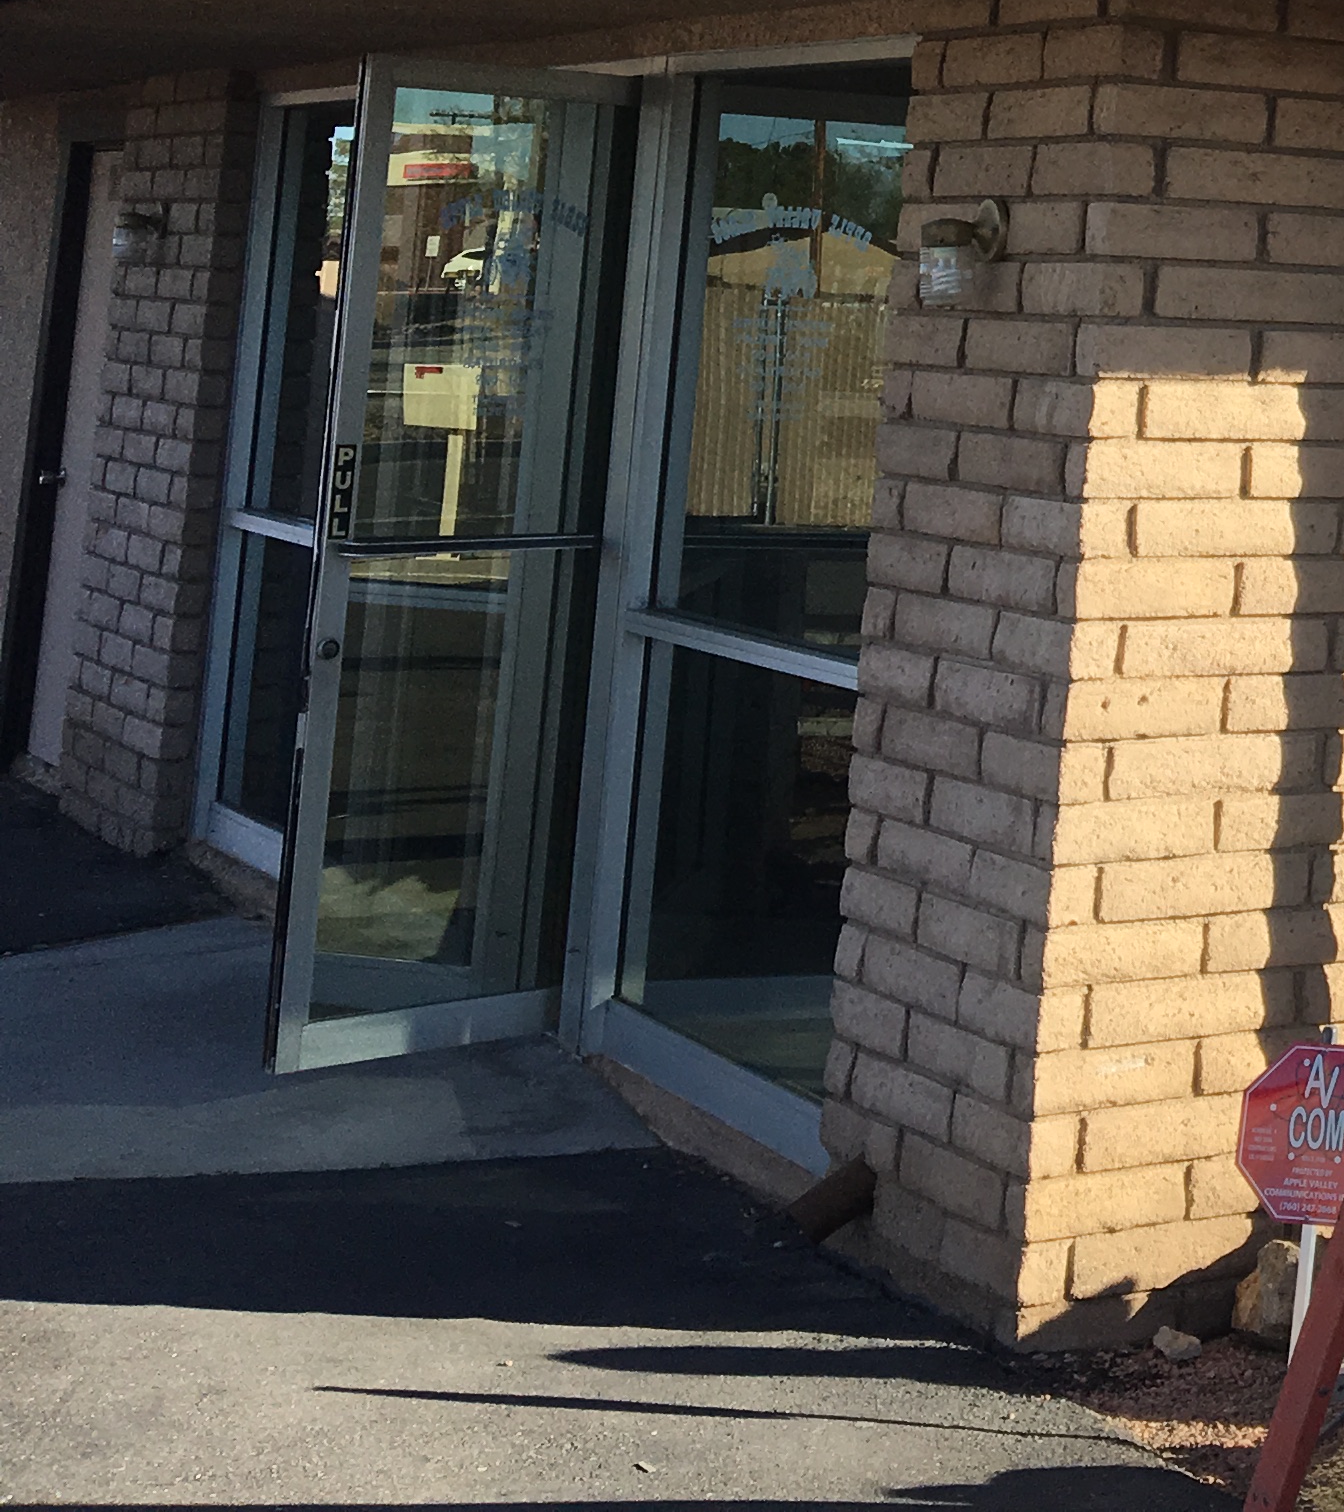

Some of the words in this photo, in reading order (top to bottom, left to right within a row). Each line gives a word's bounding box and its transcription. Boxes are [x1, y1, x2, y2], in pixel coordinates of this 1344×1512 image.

[332, 448, 354, 536] PULL
[1304, 1053, 1340, 1108] AV
[1263, 1187, 1337, 1202] COMMUNICATIONS
[1283, 1177, 1307, 1189] APPLE
[1308, 1179, 1338, 1190] VALLEY
